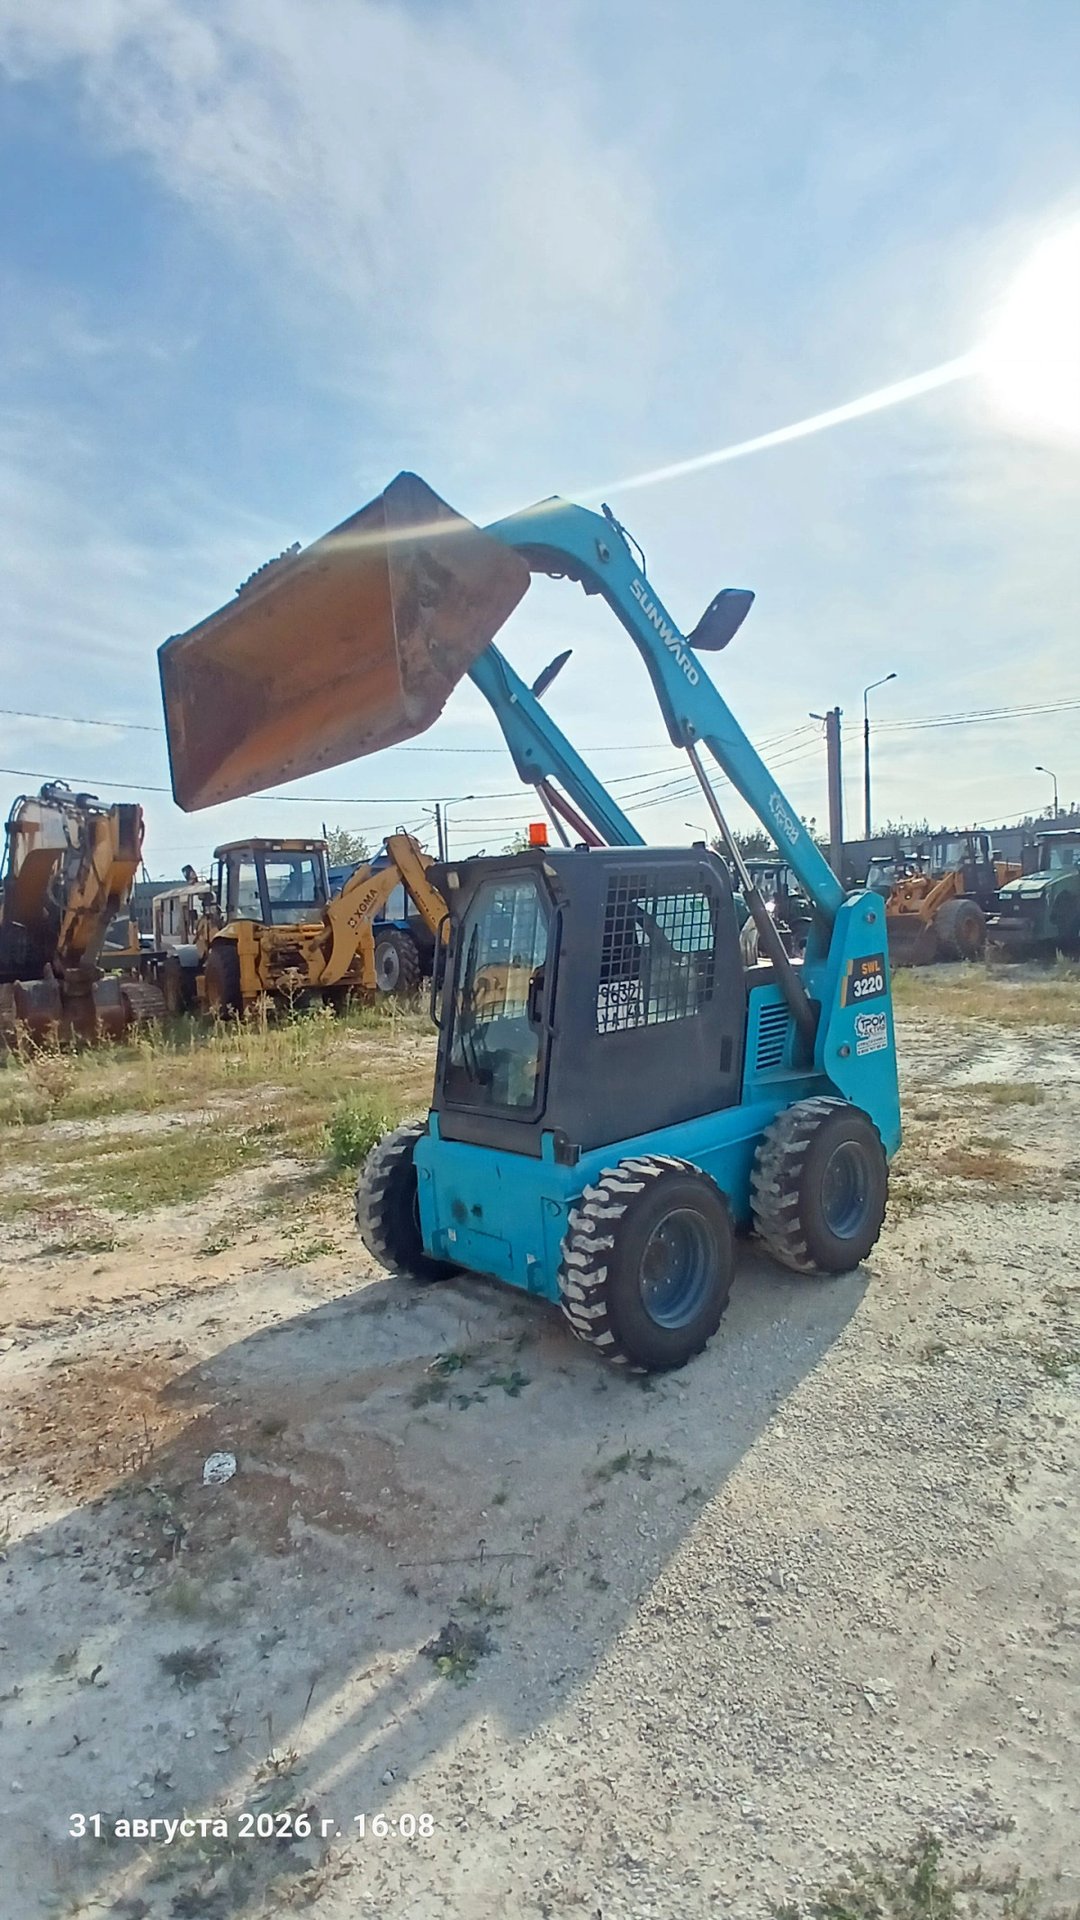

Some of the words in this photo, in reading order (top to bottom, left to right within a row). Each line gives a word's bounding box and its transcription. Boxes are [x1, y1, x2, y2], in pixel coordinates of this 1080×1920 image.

[629, 578, 700, 686] SUNWARD
[353, 889, 378, 918] XGMA
[861, 960, 880, 975] SWL
[601, 984, 637, 1005] 9632
[854, 975, 883, 997] 3220
